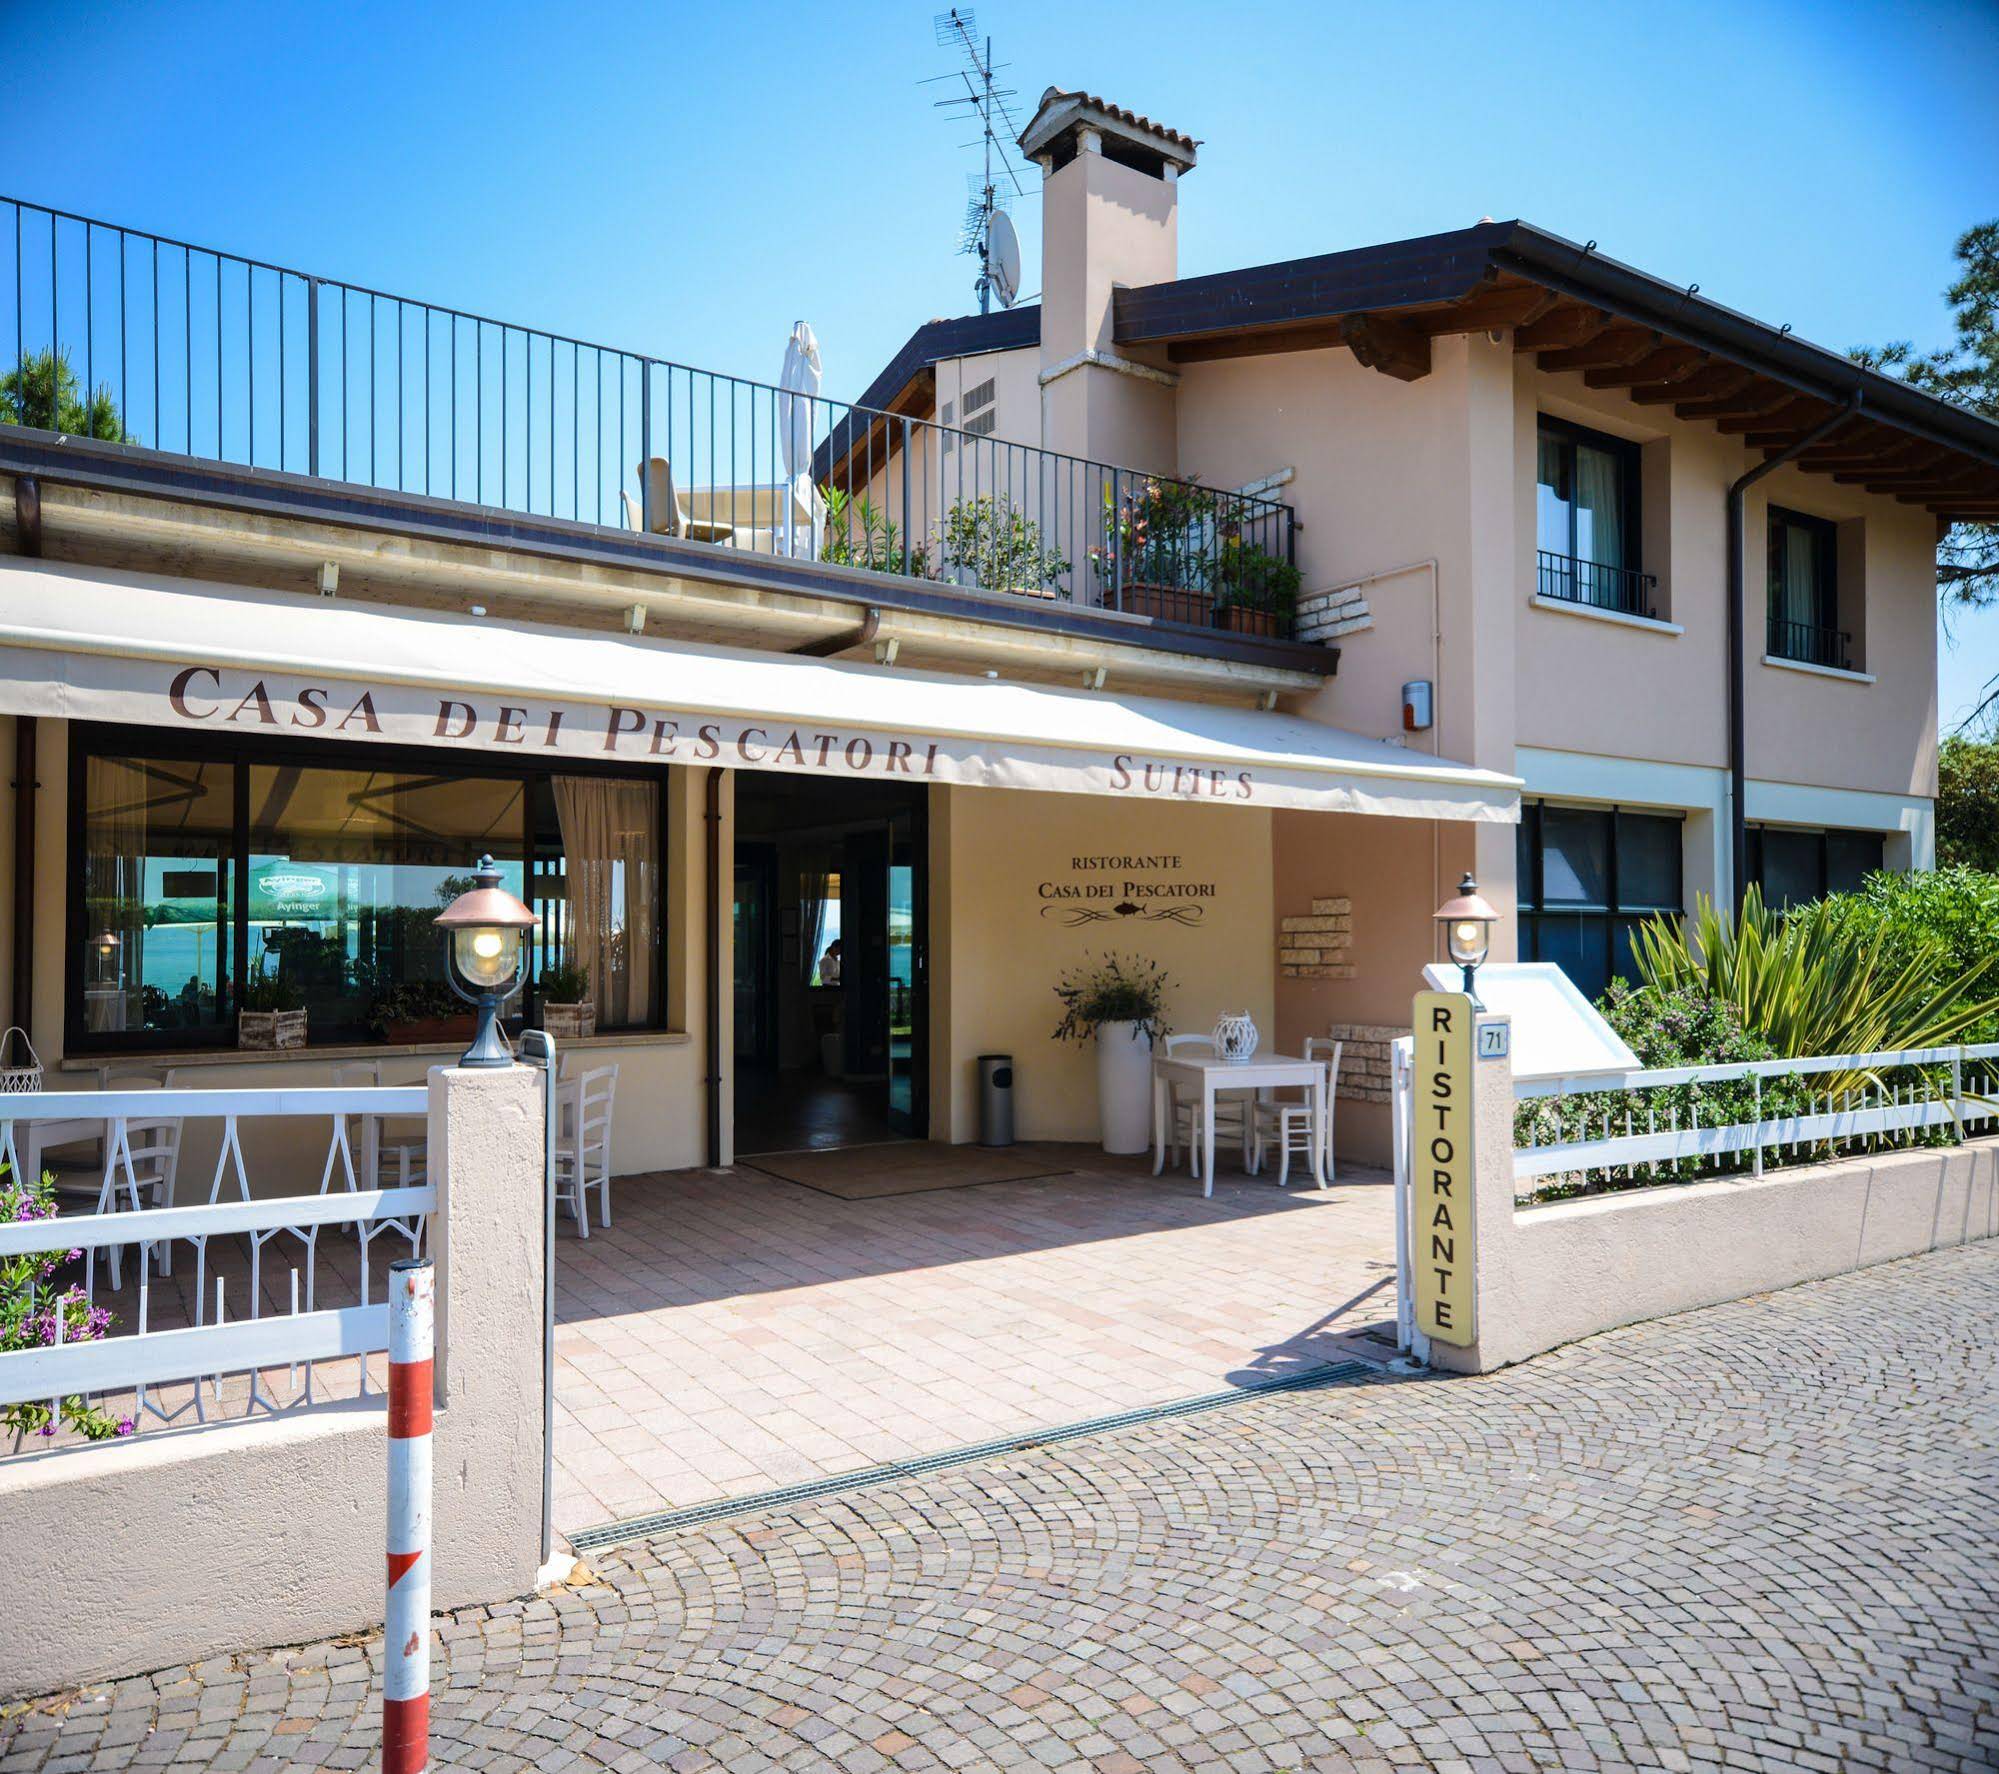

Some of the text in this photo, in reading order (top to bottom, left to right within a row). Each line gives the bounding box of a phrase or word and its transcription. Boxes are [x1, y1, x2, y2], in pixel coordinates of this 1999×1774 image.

[169, 666, 1253, 799] CASA DEI PESCATORI SUITES
[1072, 855, 1182, 870] RISTORANTE
[1038, 882, 1216, 899] CASA DEI PESCATORI
[277, 901, 320, 912] Ayinger
[1486, 1031, 1501, 1049] 71
[1431, 1006, 1453, 1330] RISTORANTE
